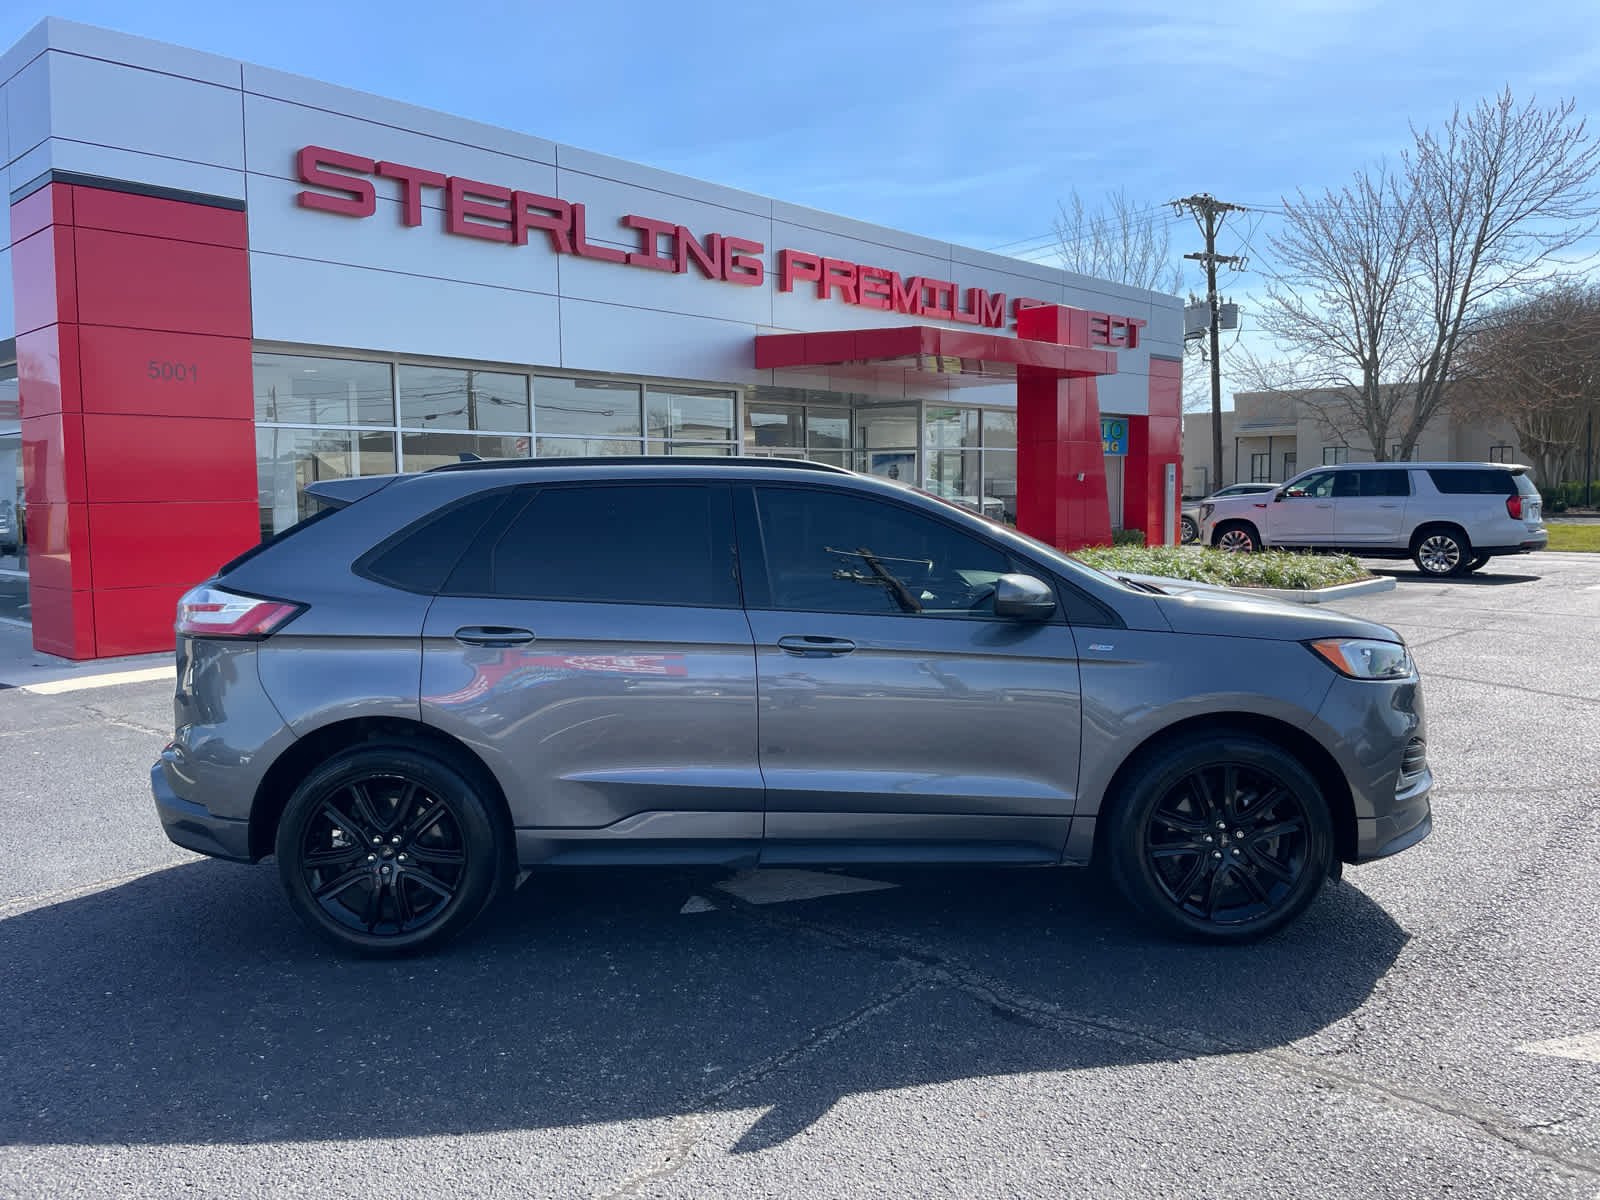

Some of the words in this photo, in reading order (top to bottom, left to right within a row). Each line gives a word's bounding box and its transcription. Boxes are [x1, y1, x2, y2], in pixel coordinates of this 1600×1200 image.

[297, 145, 764, 287] STERLING
[779, 248, 1006, 328] PREMIUM
[147, 360, 197, 384] 5001
